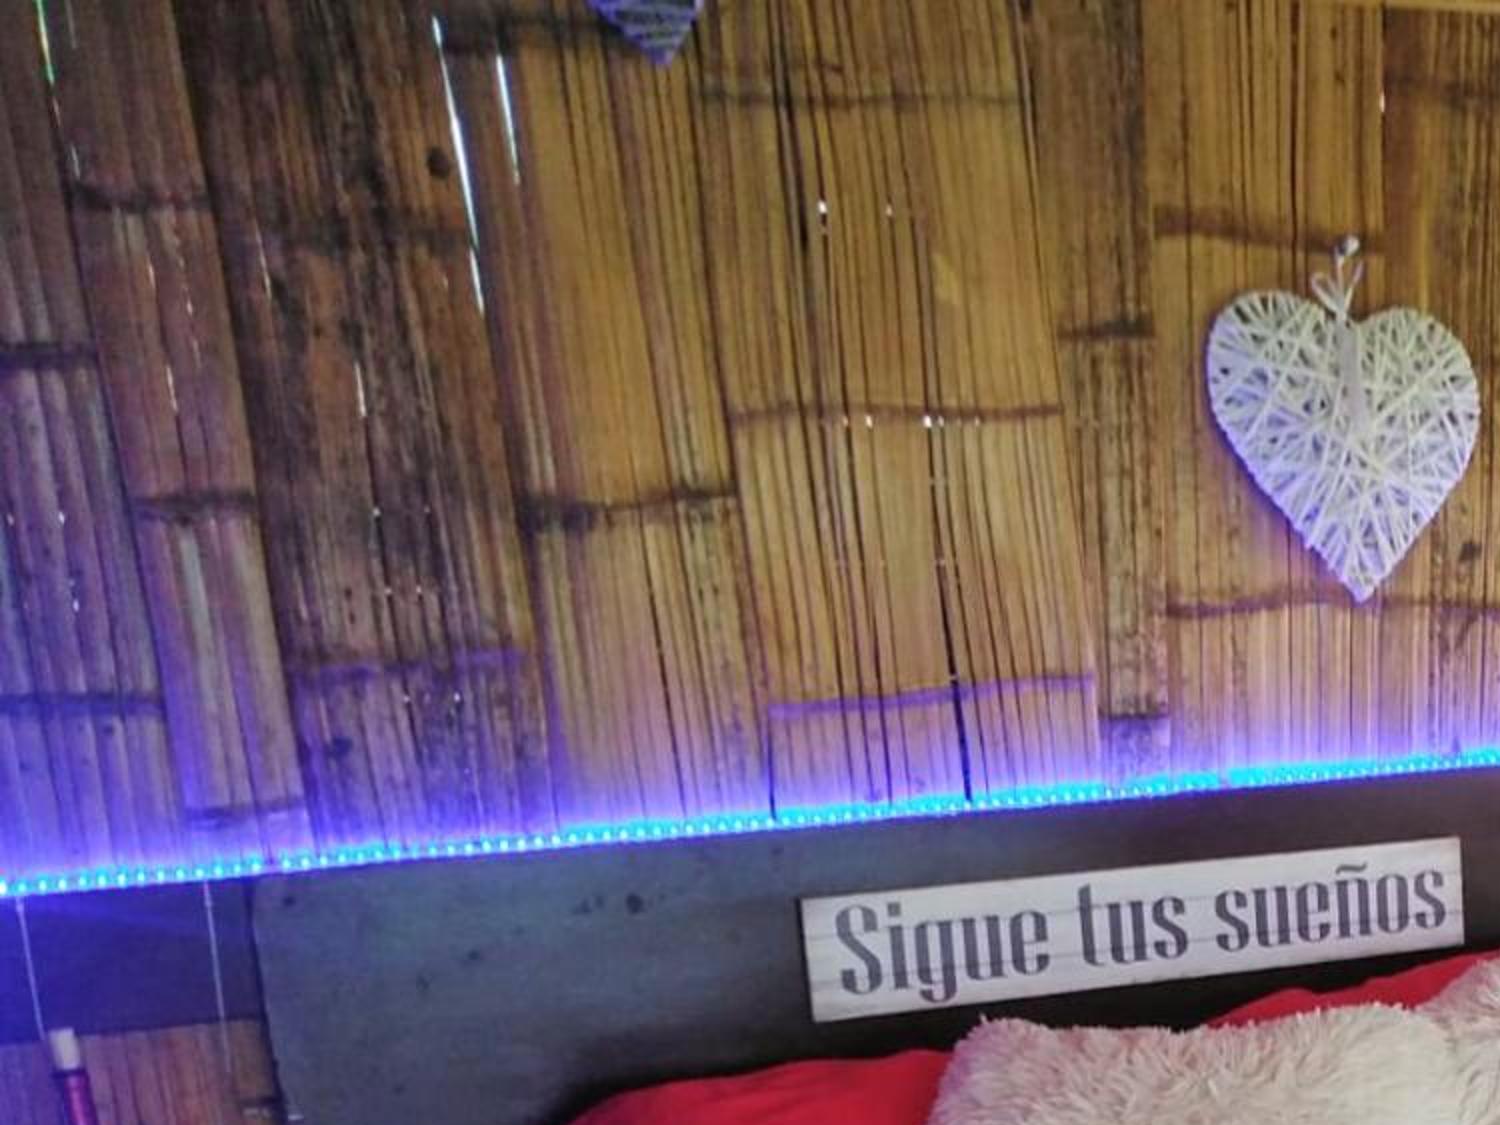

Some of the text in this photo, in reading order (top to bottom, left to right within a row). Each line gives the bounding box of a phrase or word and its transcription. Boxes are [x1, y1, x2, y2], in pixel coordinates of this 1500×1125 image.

[834, 862, 1449, 1002] Sigue tus sueños
